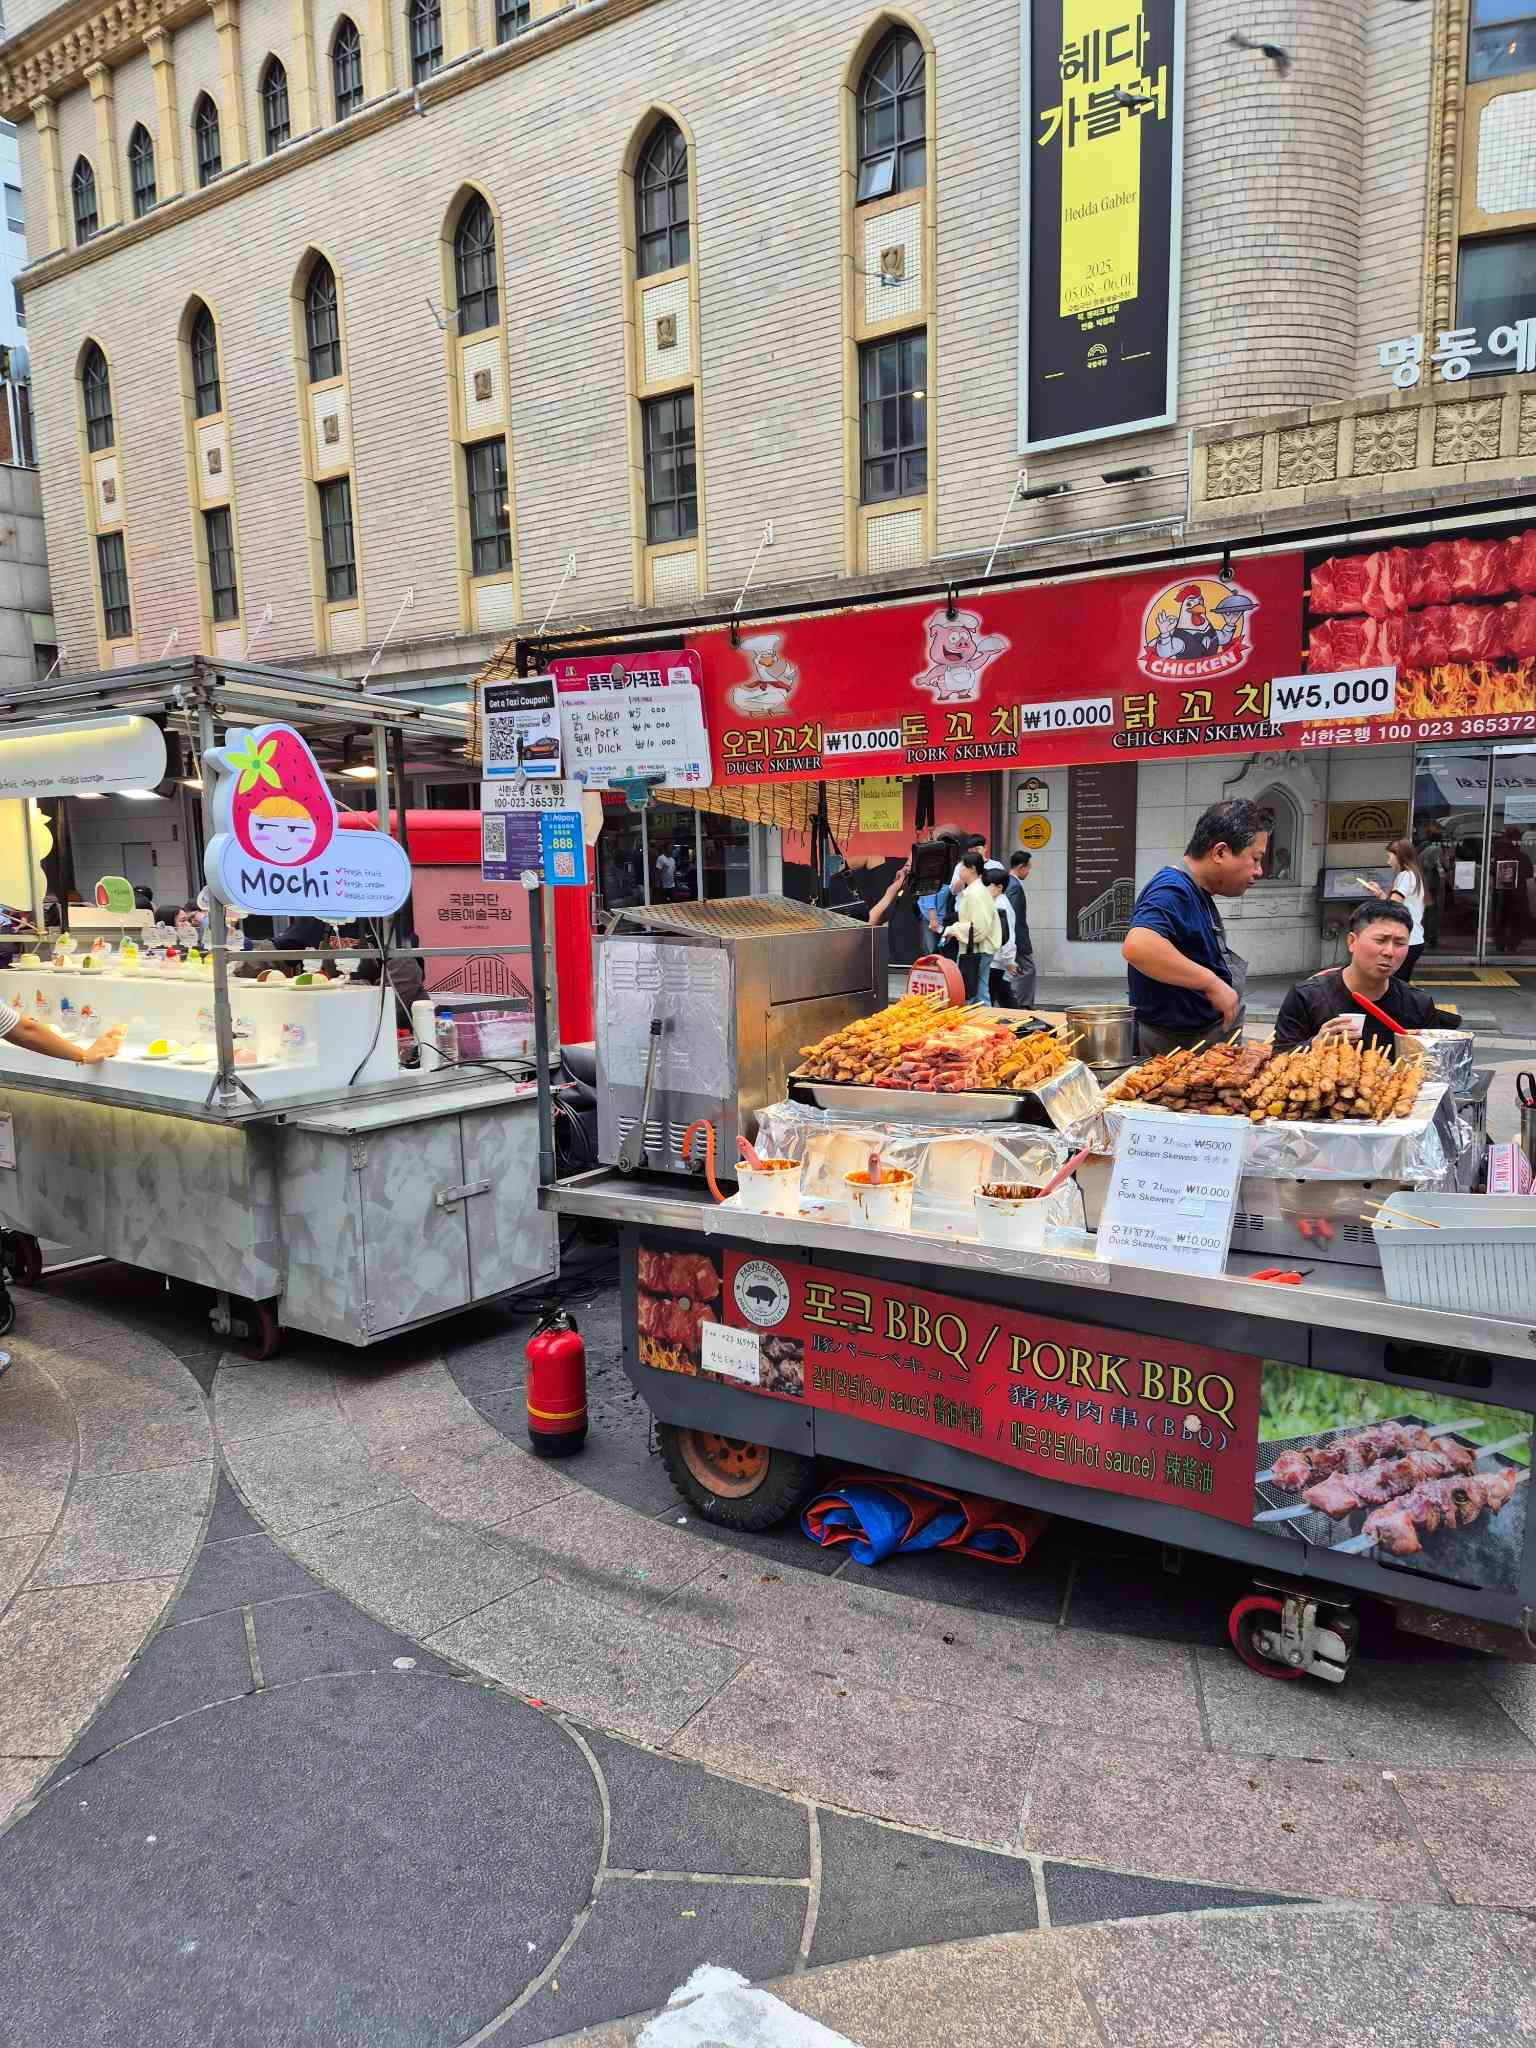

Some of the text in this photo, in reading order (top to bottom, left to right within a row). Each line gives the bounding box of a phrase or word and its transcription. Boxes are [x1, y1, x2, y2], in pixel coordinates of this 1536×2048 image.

[1058, 13, 1151, 84] 헤다
[1038, 65, 1167, 149] 가블러
[1065, 191, 1137, 223] Hedda Gabler
[1150, 652, 1236, 675] CHICKEN
[489, 699, 500, 708] Get
[506, 698, 519, 706] Taxi
[1276, 678, 1389, 711] ₩5,000
[1024, 704, 1112, 730] ₩10.000
[721, 721, 823, 758] 오리꼬치
[827, 730, 900, 752] ₩10.000
[1112, 721, 1284, 749] CHICKEN SKEWER
[1300, 715, 1536, 746] 신한은행 100 023 365372
[906, 741, 1019, 764] PORK SKEWER
[726, 756, 822, 775] DUCK SKEWER
[494, 798, 567, 809] 100-023-365372
[1026, 792, 1040, 804] 35
[240, 867, 329, 898] Mochi
[448, 892, 500, 907] 국립극단
[437, 908, 513, 921] 명동예술극장
[1127, 1147, 1160, 1159] Chicken
[1162, 1151, 1198, 1162] Skewers
[1118, 1190, 1175, 1204] Pork Skewers
[1108, 1236, 1130, 1246] Duck
[1132, 1239, 1168, 1252] Skewers
[803, 1282, 875, 1334] 포크
[884, 1297, 970, 1373] BBQ
[1008, 1334, 1130, 1397] PORK
[1138, 1360, 1236, 1431] BBQ
[1103, 1449, 1156, 1481] sauce)
